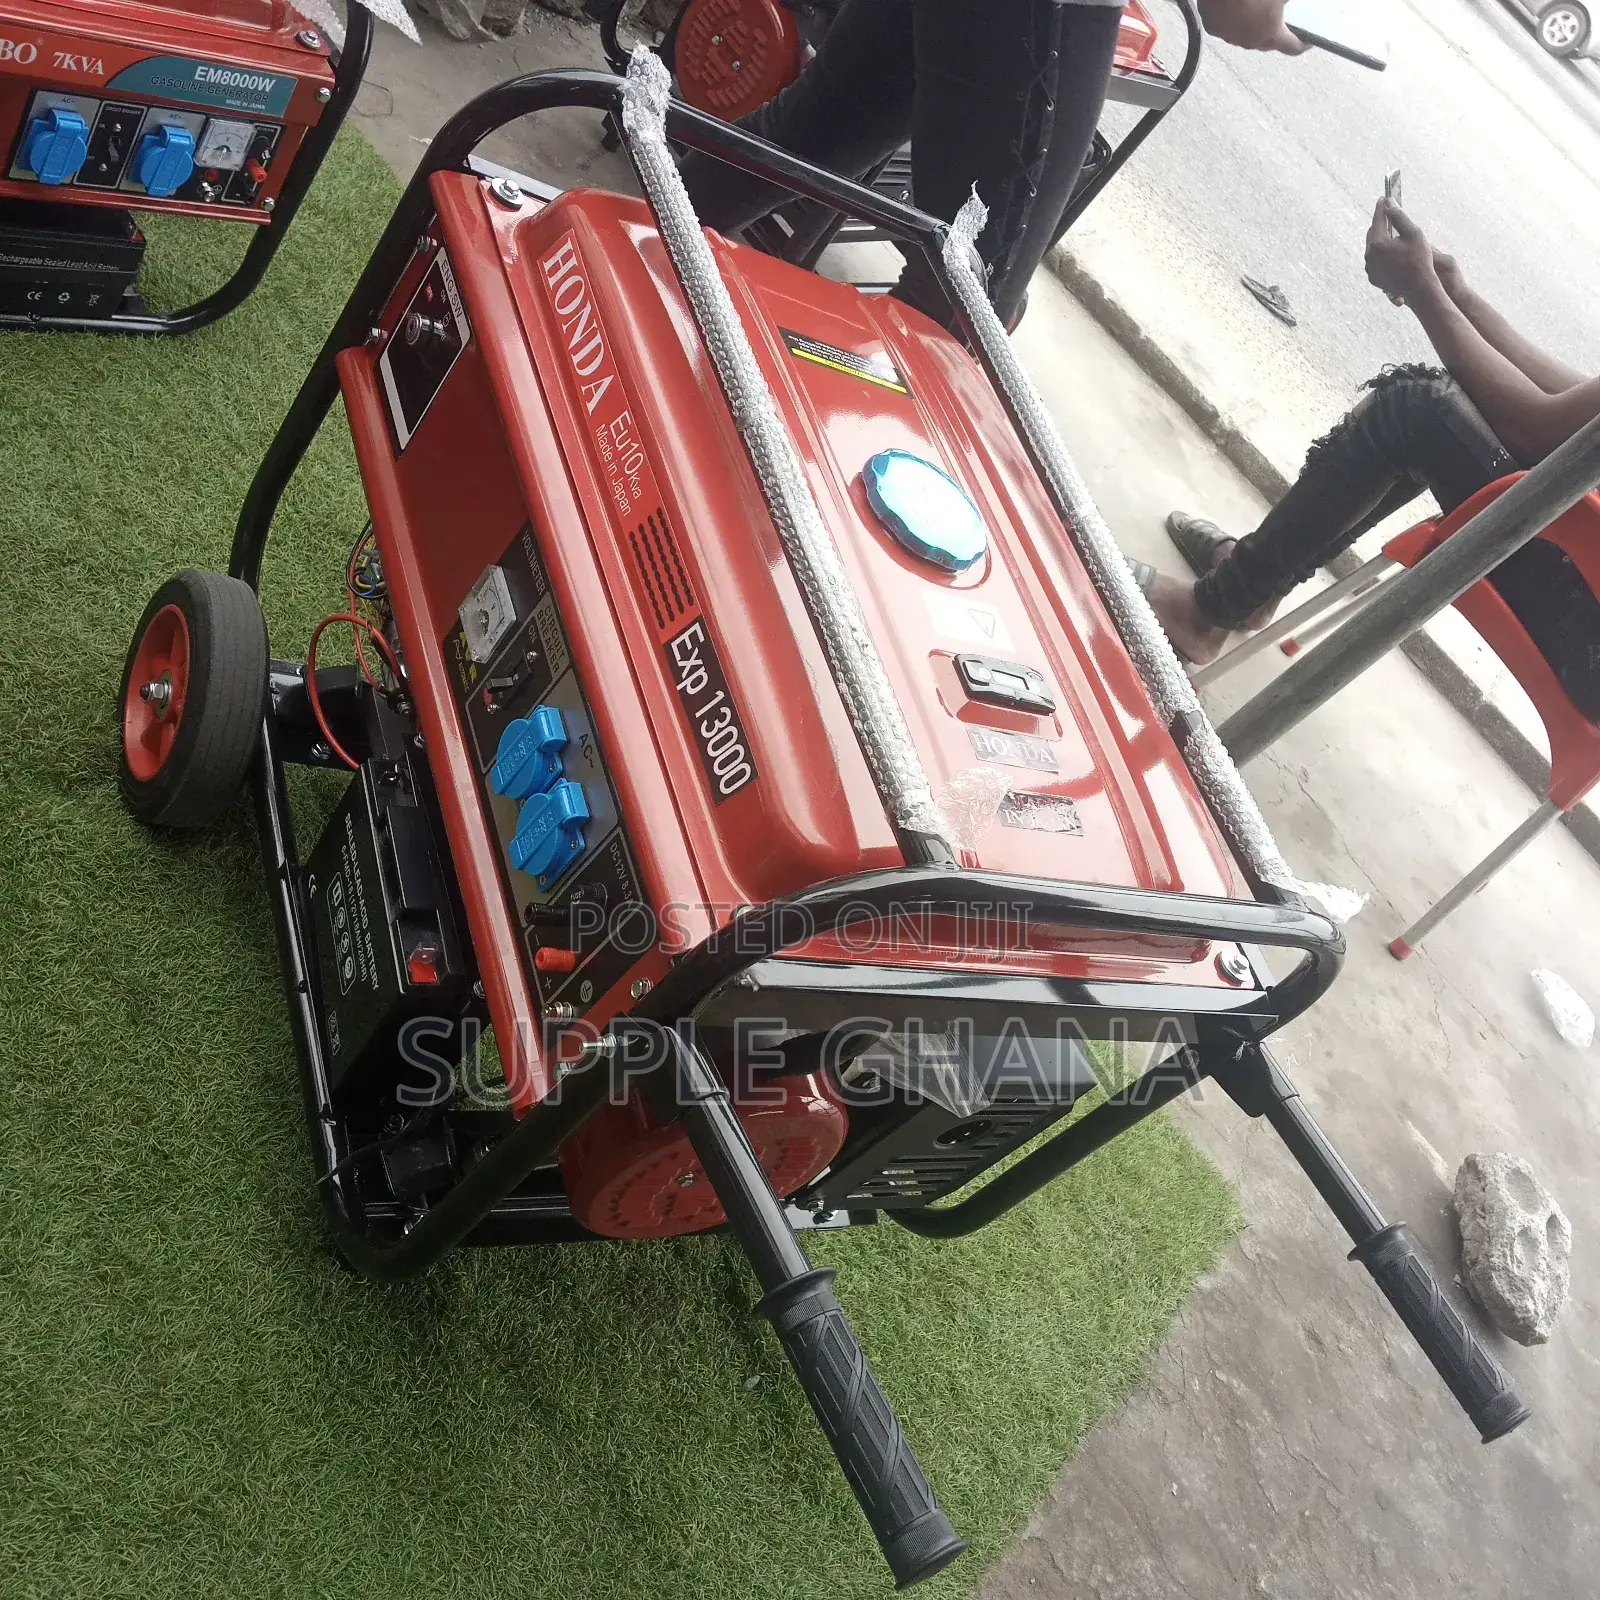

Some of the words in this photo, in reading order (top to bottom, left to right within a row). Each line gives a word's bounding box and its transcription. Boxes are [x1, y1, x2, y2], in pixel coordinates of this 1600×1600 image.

[53, 51, 104, 76] 7KVA
[194, 65, 276, 93] EM8000W
[151, 76, 204, 94] GASOLINE
[207, 85, 269, 103] GENERATOR
[225, 98, 241, 107] MADE
[248, 102, 267, 111] JAPAN
[543, 237, 615, 417] HONDA
[594, 423, 614, 463] Made
[606, 459, 619, 477] in
[612, 476, 632, 517] Japan
[522, 529, 546, 597] VOLTMETER
[527, 625, 538, 644] ON
[536, 609, 560, 674] BREAKER
[543, 605, 566, 661] CIRCUIT
[670, 622, 709, 695] Exp
[694, 690, 752, 795] 13000
[609, 841, 627, 881] DC12V
[364, 931, 380, 991] BATTERY
